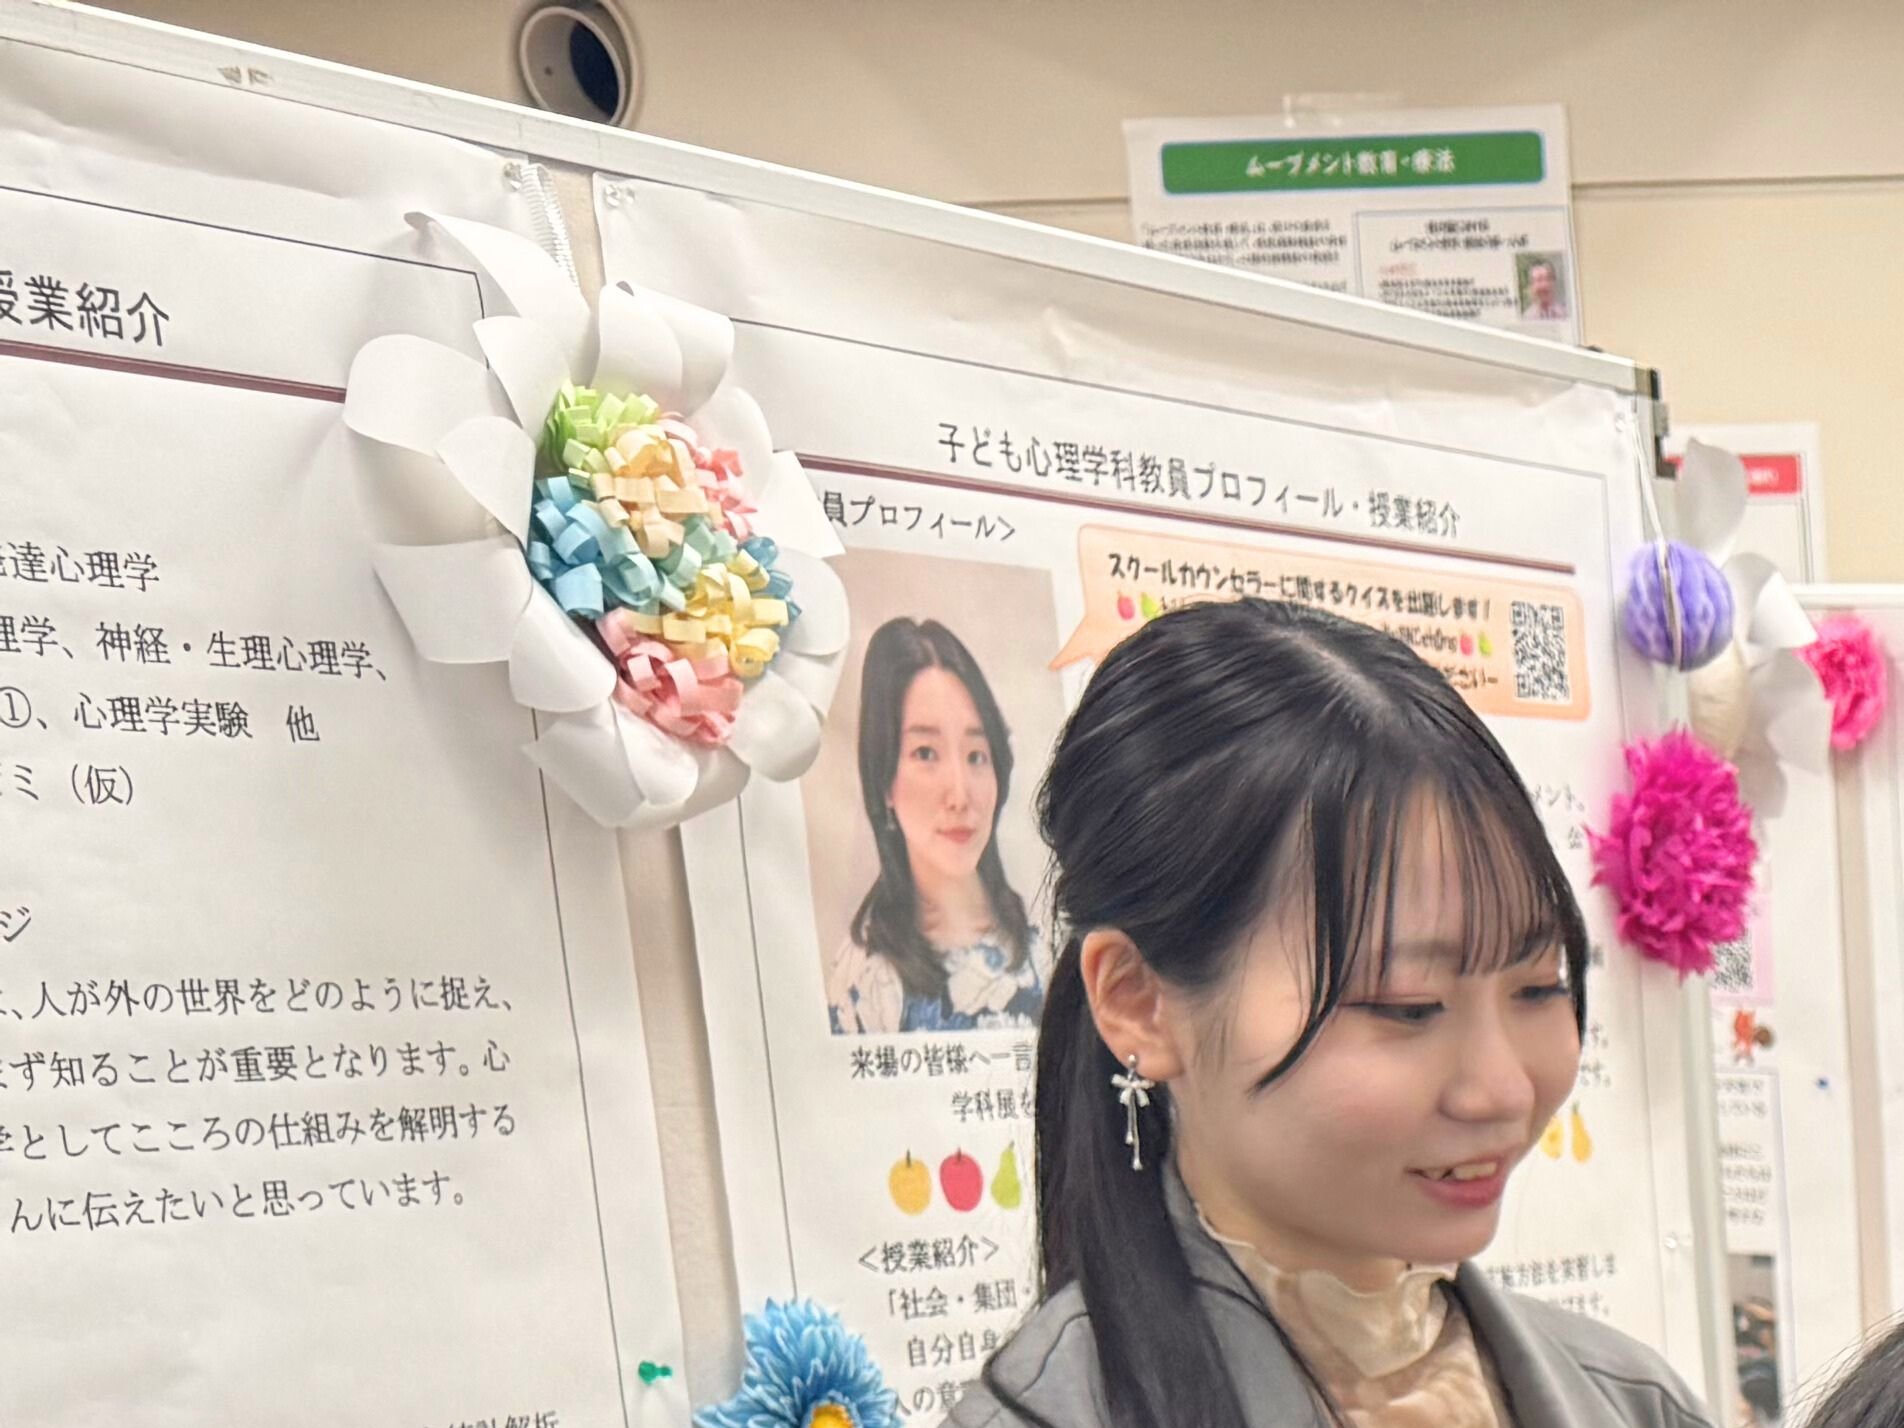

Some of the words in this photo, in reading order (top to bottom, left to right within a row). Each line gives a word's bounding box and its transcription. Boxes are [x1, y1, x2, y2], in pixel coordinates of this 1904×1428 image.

[938, 422, 1461, 539] 子ども心理学科教員プロフィール・授業紹介
[0, 541, 160, 592] 達心理学
[286, 704, 321, 743] 他
[0, 976, 513, 1020] 、人が外の世界をどのように捉え、
[0, 1040, 512, 1091] ず知ることが重要となります。心
[851, 1041, 1033, 1080] 来場の皆様へ一言
[11, 1170, 465, 1233] んに伝えたいと思っています。
